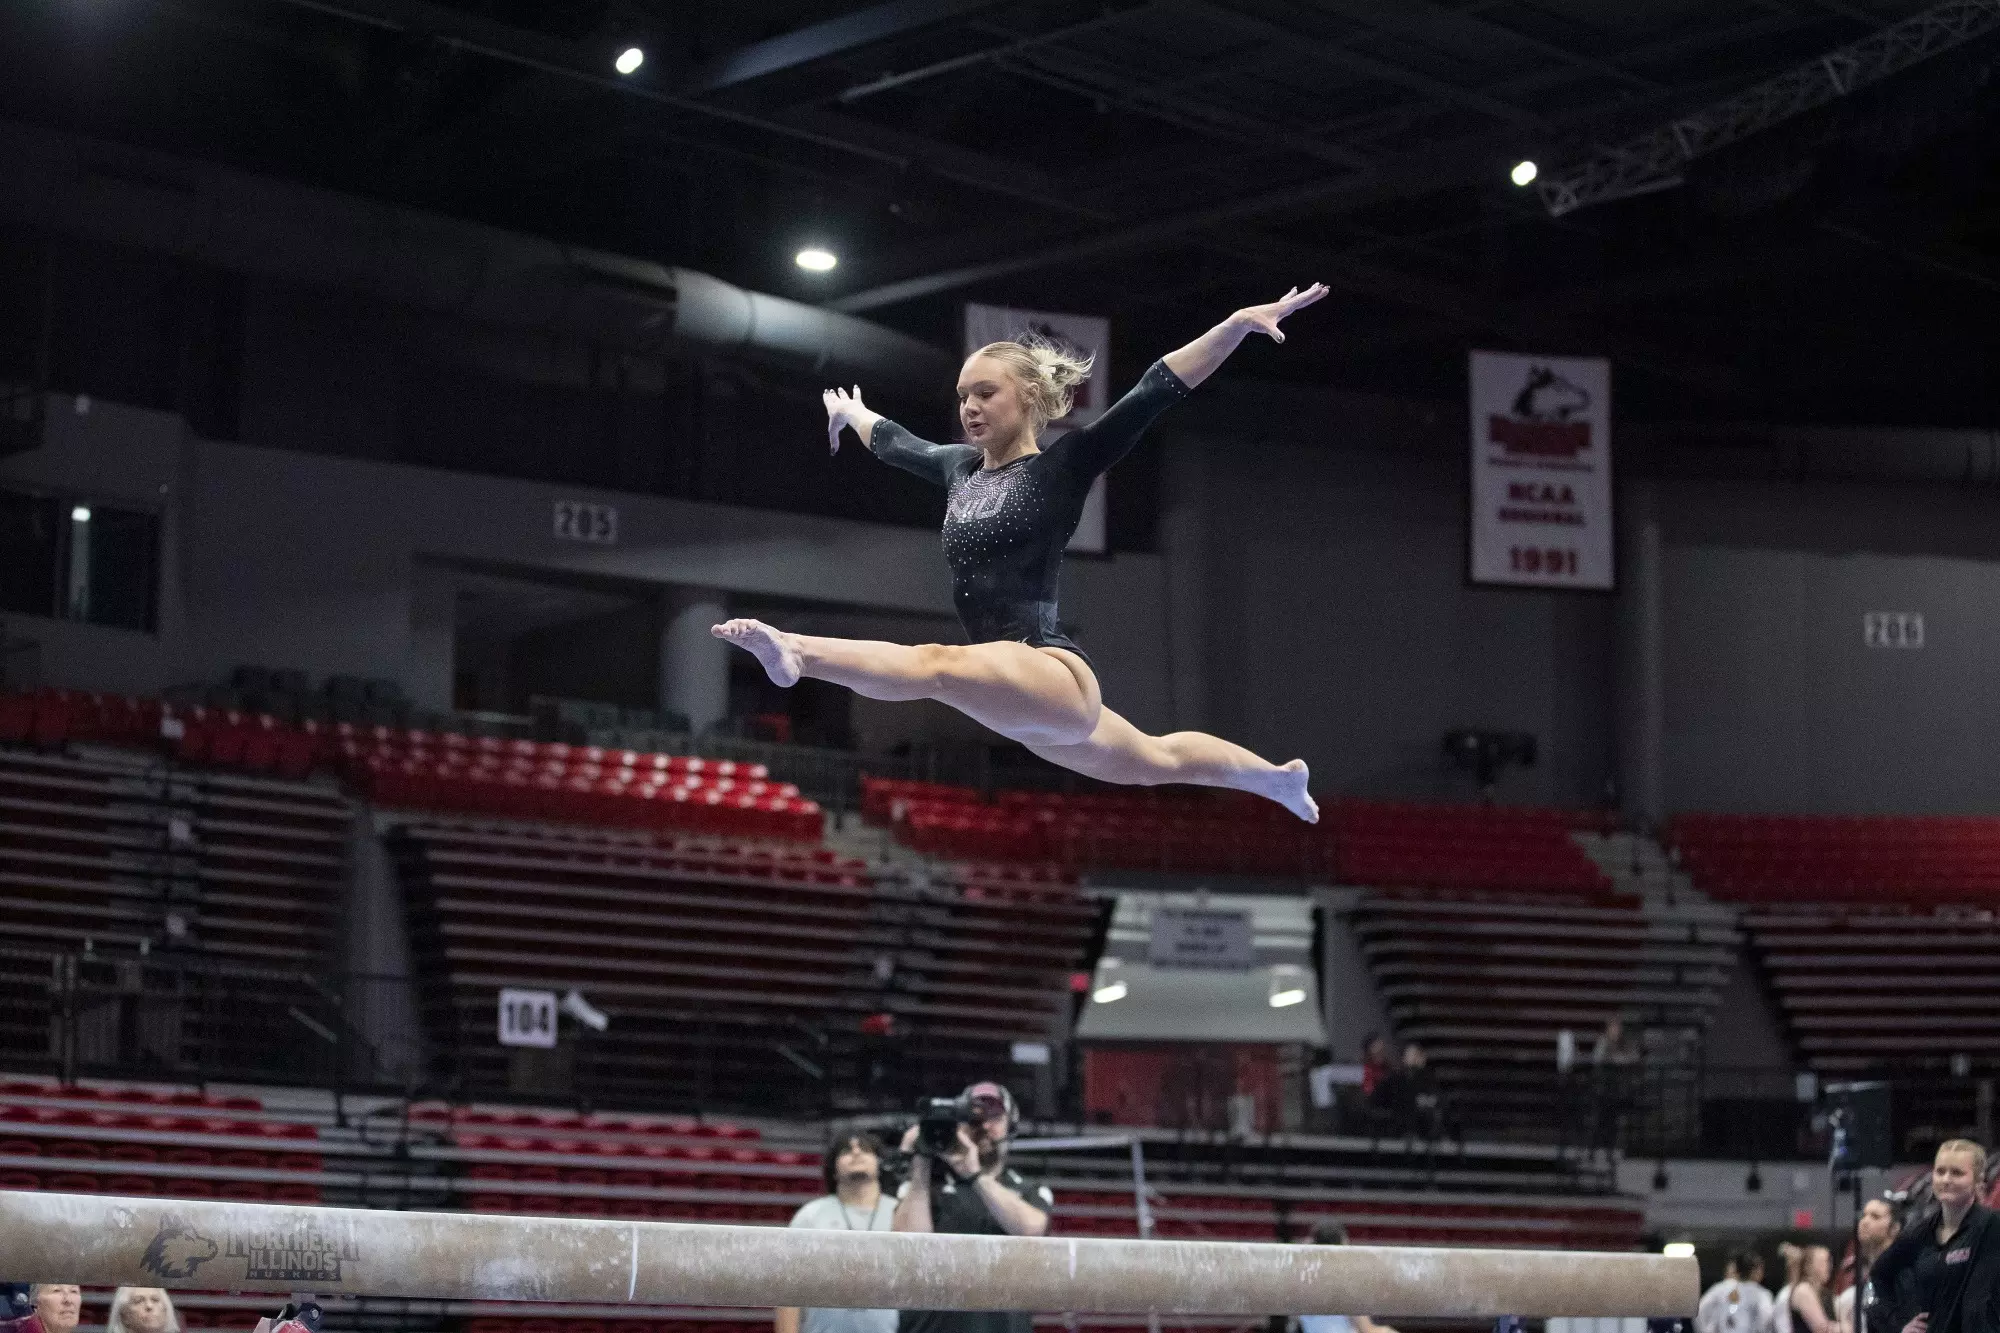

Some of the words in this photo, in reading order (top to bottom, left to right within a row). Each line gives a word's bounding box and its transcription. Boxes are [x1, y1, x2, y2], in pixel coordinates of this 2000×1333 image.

[1508, 483, 1575, 505] NCAA
[560, 505, 611, 537] 205
[1509, 546, 1578, 576] 1991
[506, 1002, 550, 1035] 104
[226, 1217, 359, 1260] NORTHERN
[249, 1249, 338, 1272] ILLINOIS
[249, 1270, 338, 1280] HUSKIES
